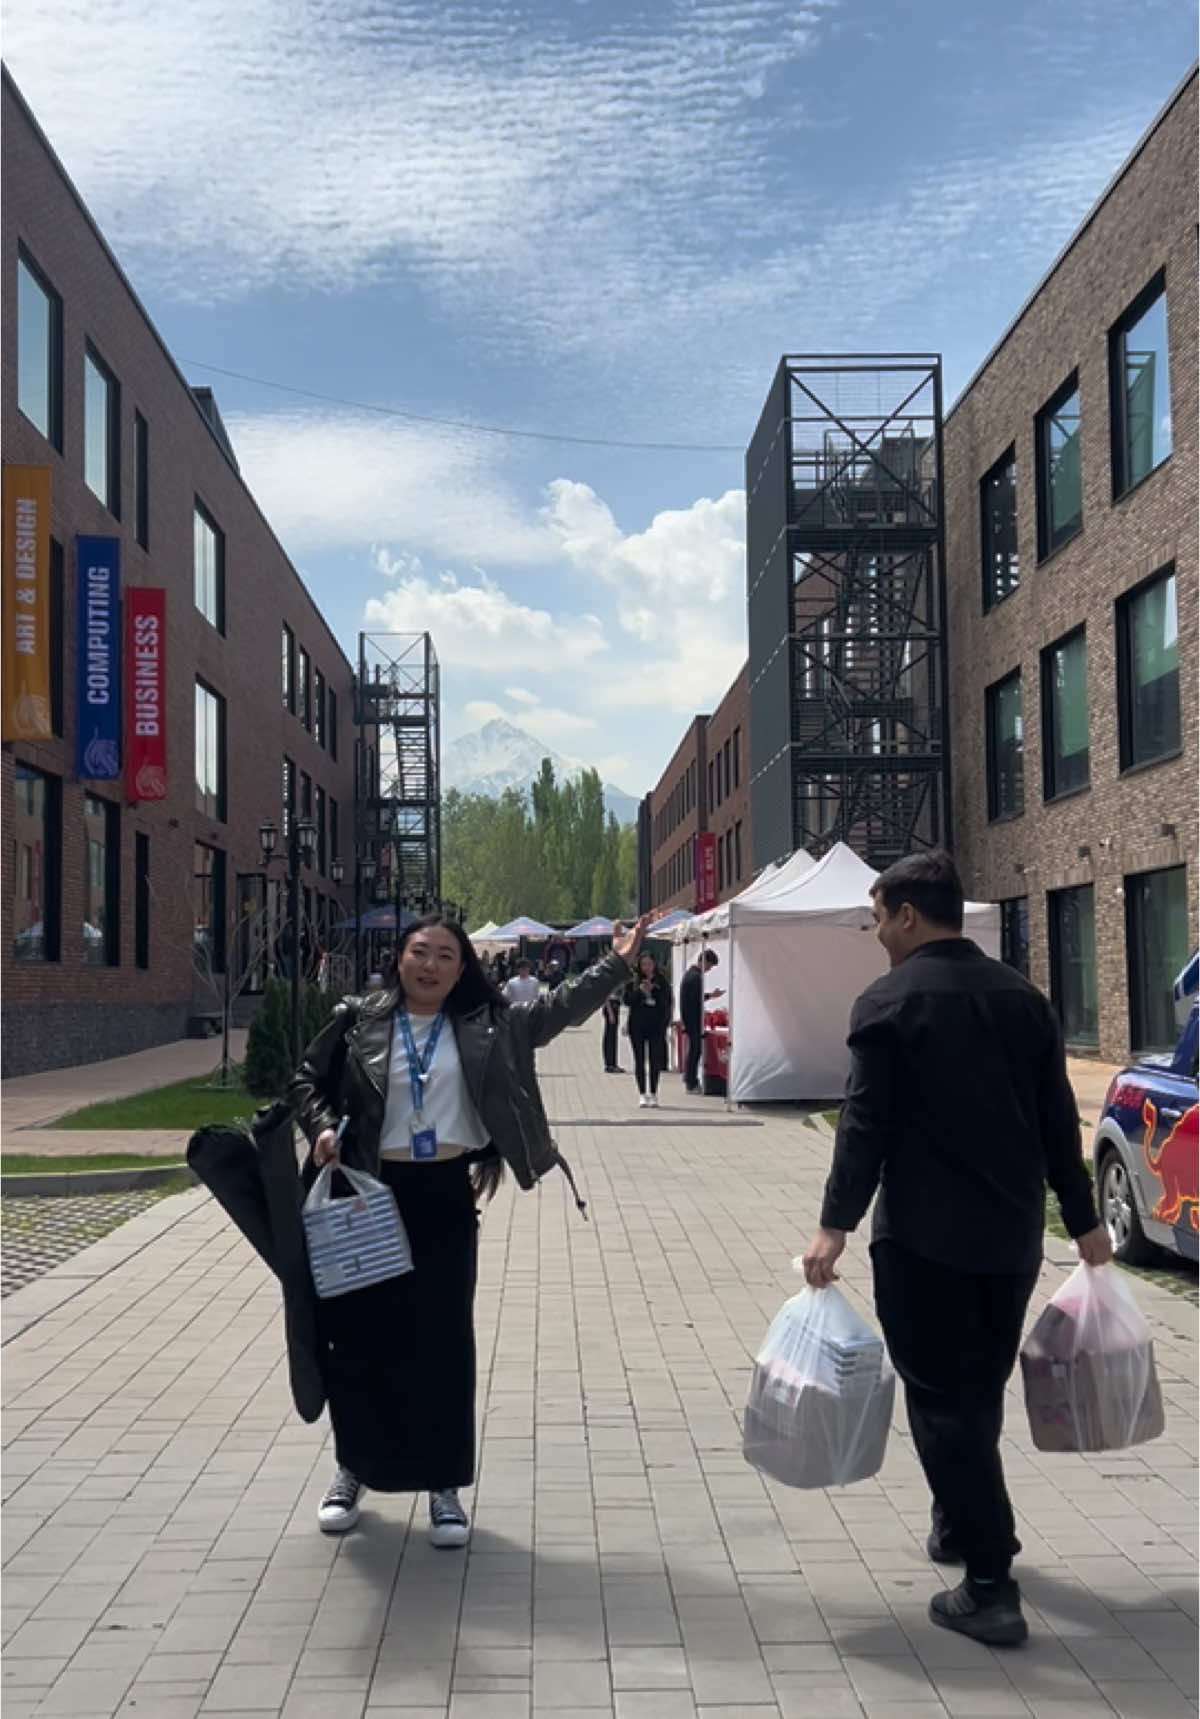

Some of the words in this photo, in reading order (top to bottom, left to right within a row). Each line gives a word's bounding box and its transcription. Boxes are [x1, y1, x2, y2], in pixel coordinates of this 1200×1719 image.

[16, 498, 38, 580] DESIGN
[16, 588, 37, 605] &
[16, 613, 37, 654] ART
[88, 567, 111, 705] COMPUTING
[135, 614, 160, 737] BUSINESS
